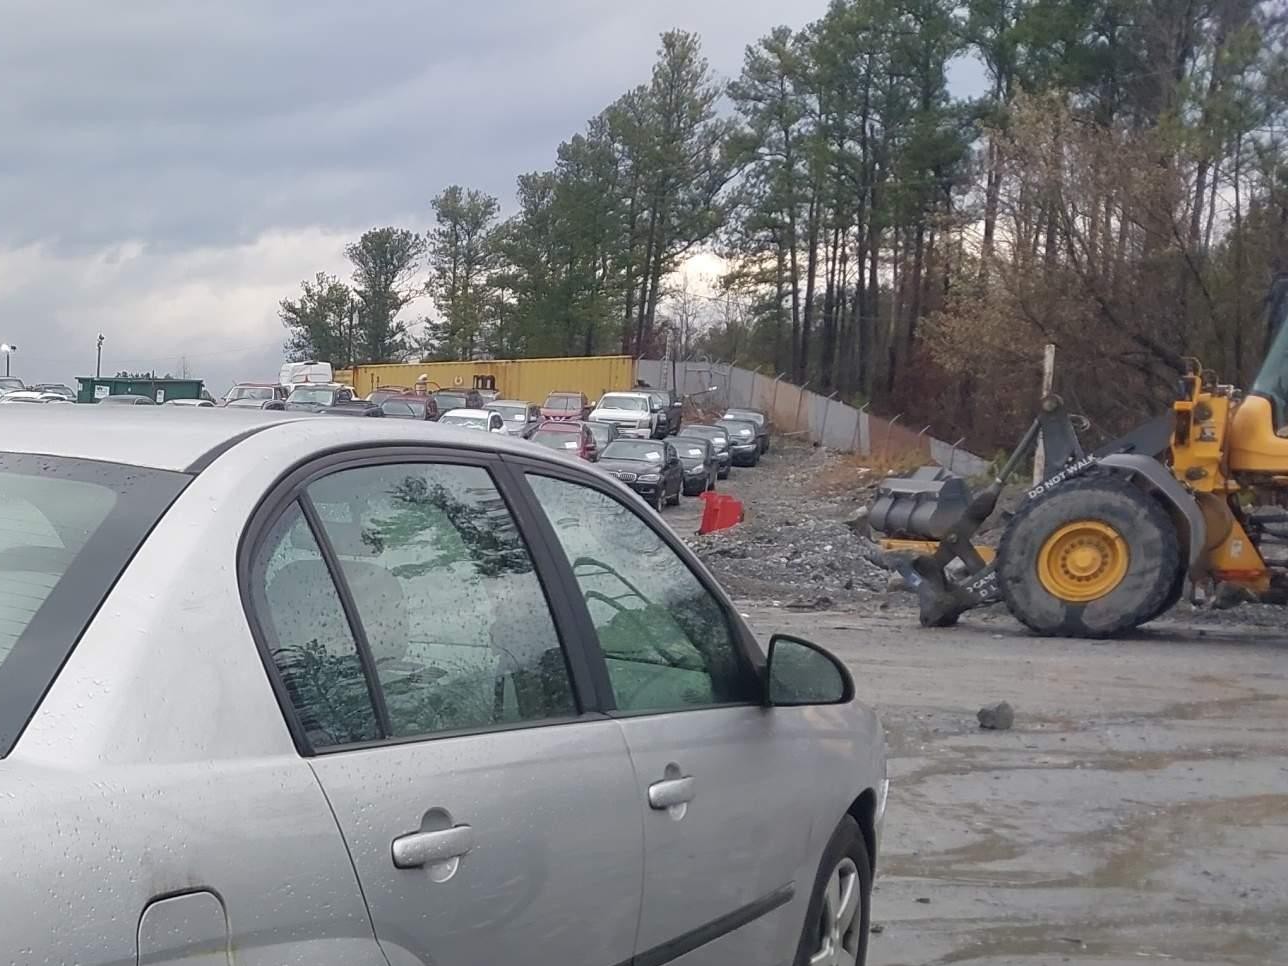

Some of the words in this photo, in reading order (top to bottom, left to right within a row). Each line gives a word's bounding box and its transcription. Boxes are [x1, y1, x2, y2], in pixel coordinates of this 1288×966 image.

[1028, 485, 1045, 499] DO
[1044, 471, 1066, 489] NOT
[1066, 453, 1096, 474] WALK
